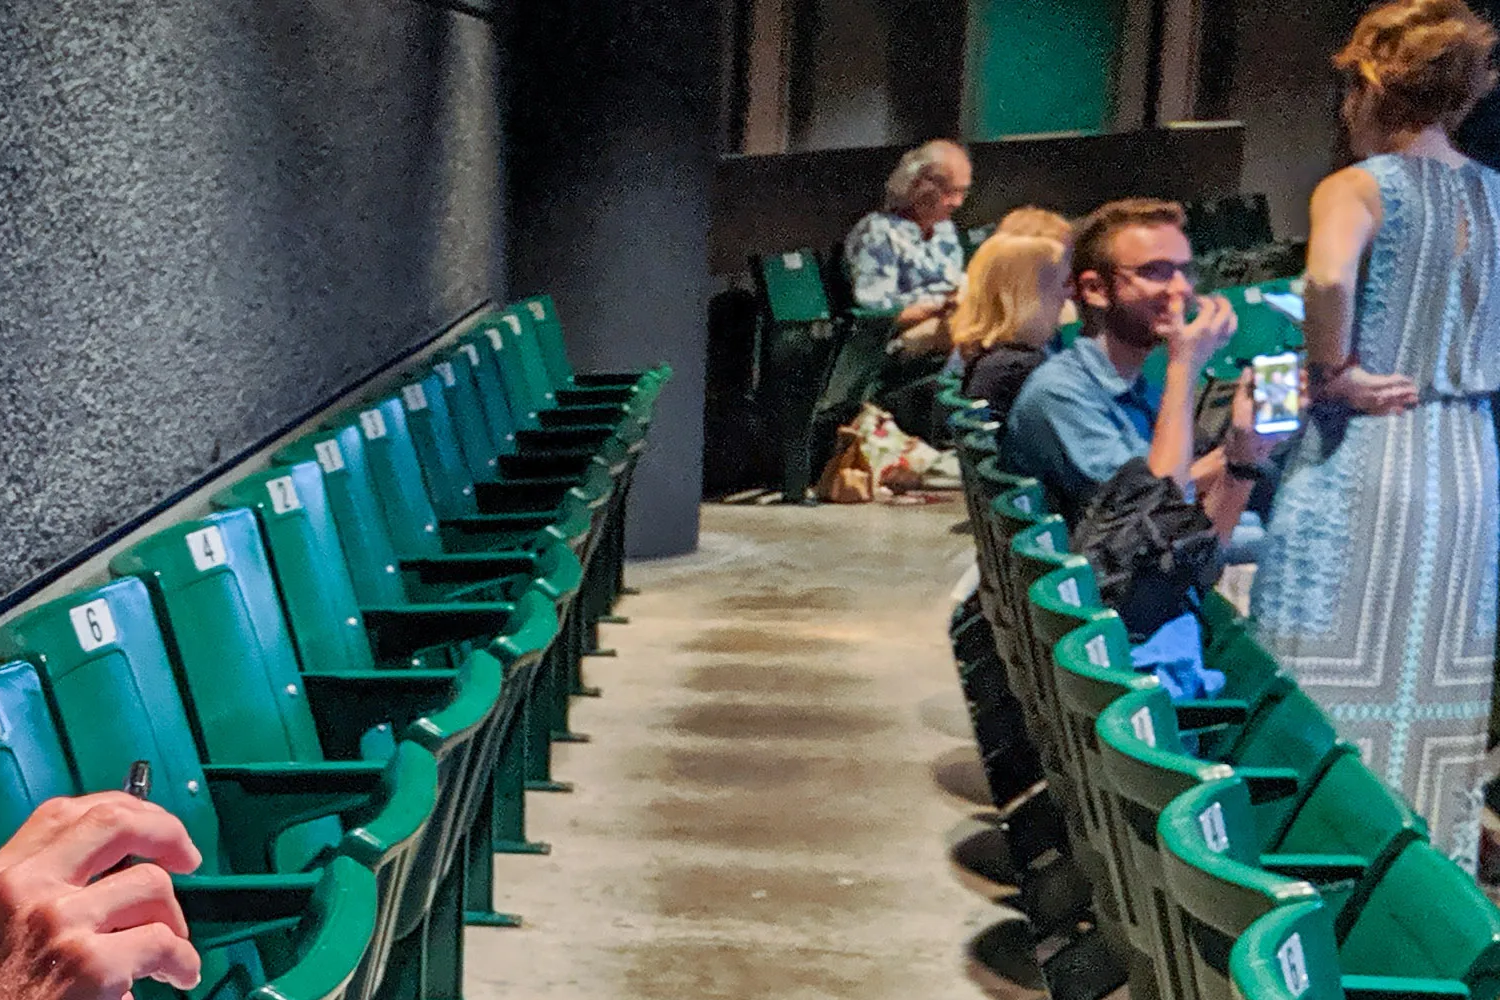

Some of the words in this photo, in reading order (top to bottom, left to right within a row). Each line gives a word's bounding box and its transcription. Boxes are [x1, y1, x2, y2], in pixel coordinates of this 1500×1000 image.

[277, 481, 291, 509] 2
[202, 532, 216, 562] 4
[85, 607, 103, 643] 6
